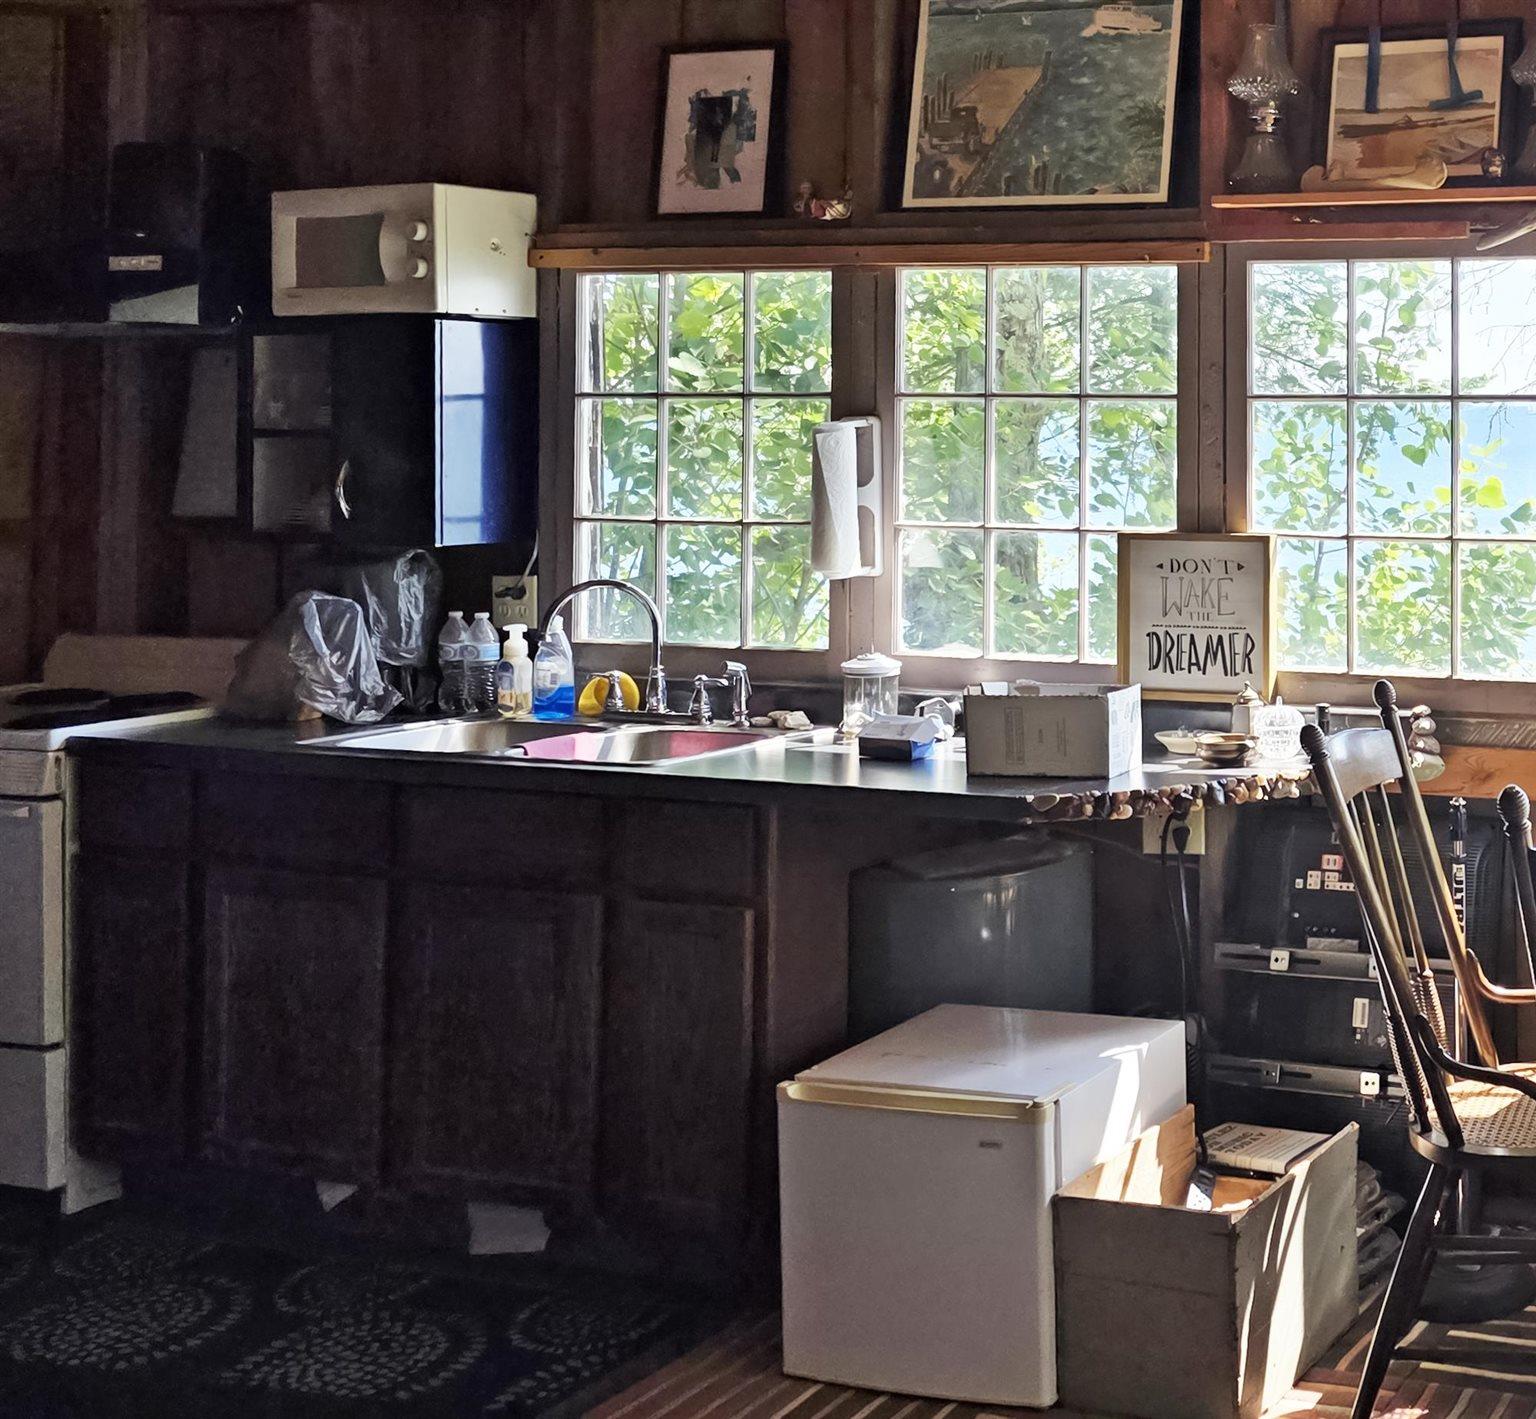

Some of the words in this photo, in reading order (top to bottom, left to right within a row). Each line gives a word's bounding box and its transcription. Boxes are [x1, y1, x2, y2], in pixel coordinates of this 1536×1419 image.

[1169, 558, 1235, 575] DON'T
[1160, 576, 1236, 618] WAKE
[1187, 611, 1215, 622] THE
[1146, 629, 1256, 678] DREAMER
[1224, 1132, 1266, 1153] TODAY
